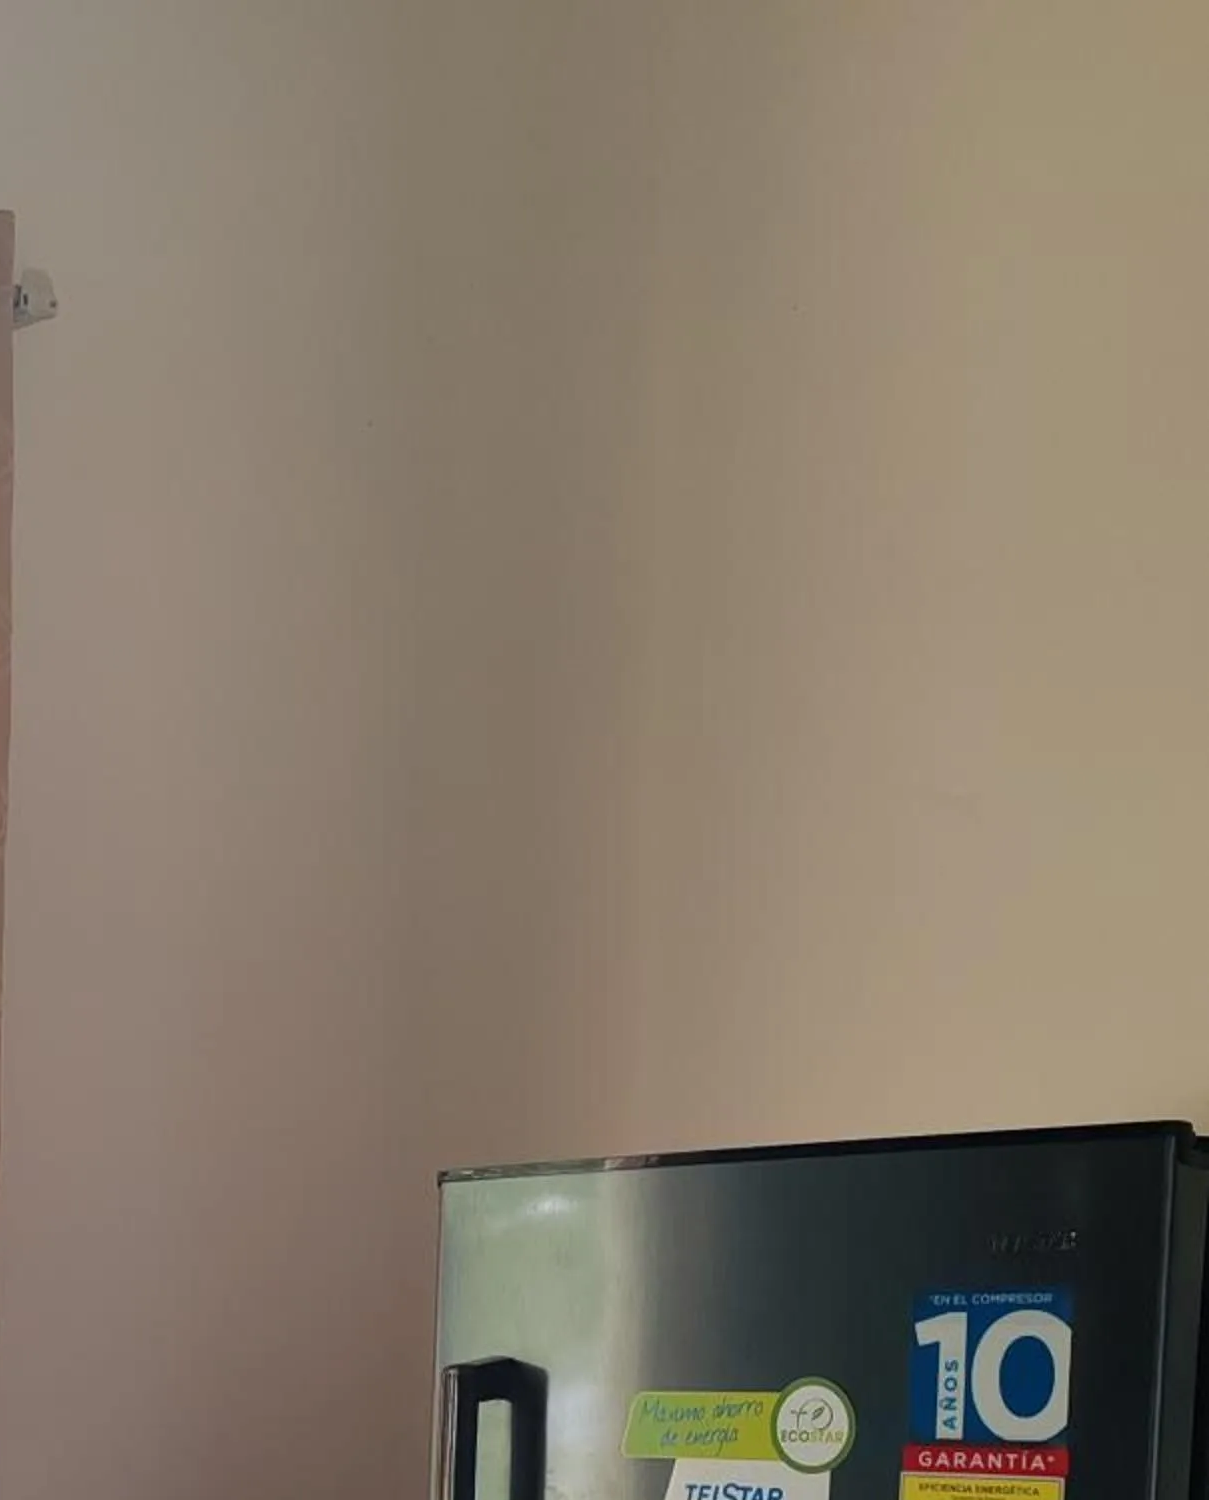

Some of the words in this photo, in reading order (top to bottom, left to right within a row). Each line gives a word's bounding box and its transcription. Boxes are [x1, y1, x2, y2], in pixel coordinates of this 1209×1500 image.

[953, 1293, 968, 1306] EL
[972, 1293, 1053, 1305] COMPRESOR
[915, 1309, 1072, 1442] 10
[942, 1358, 960, 1430] AÑOS
[660, 1430, 678, 1446] de
[780, 1427, 844, 1444] ECOSTAR
